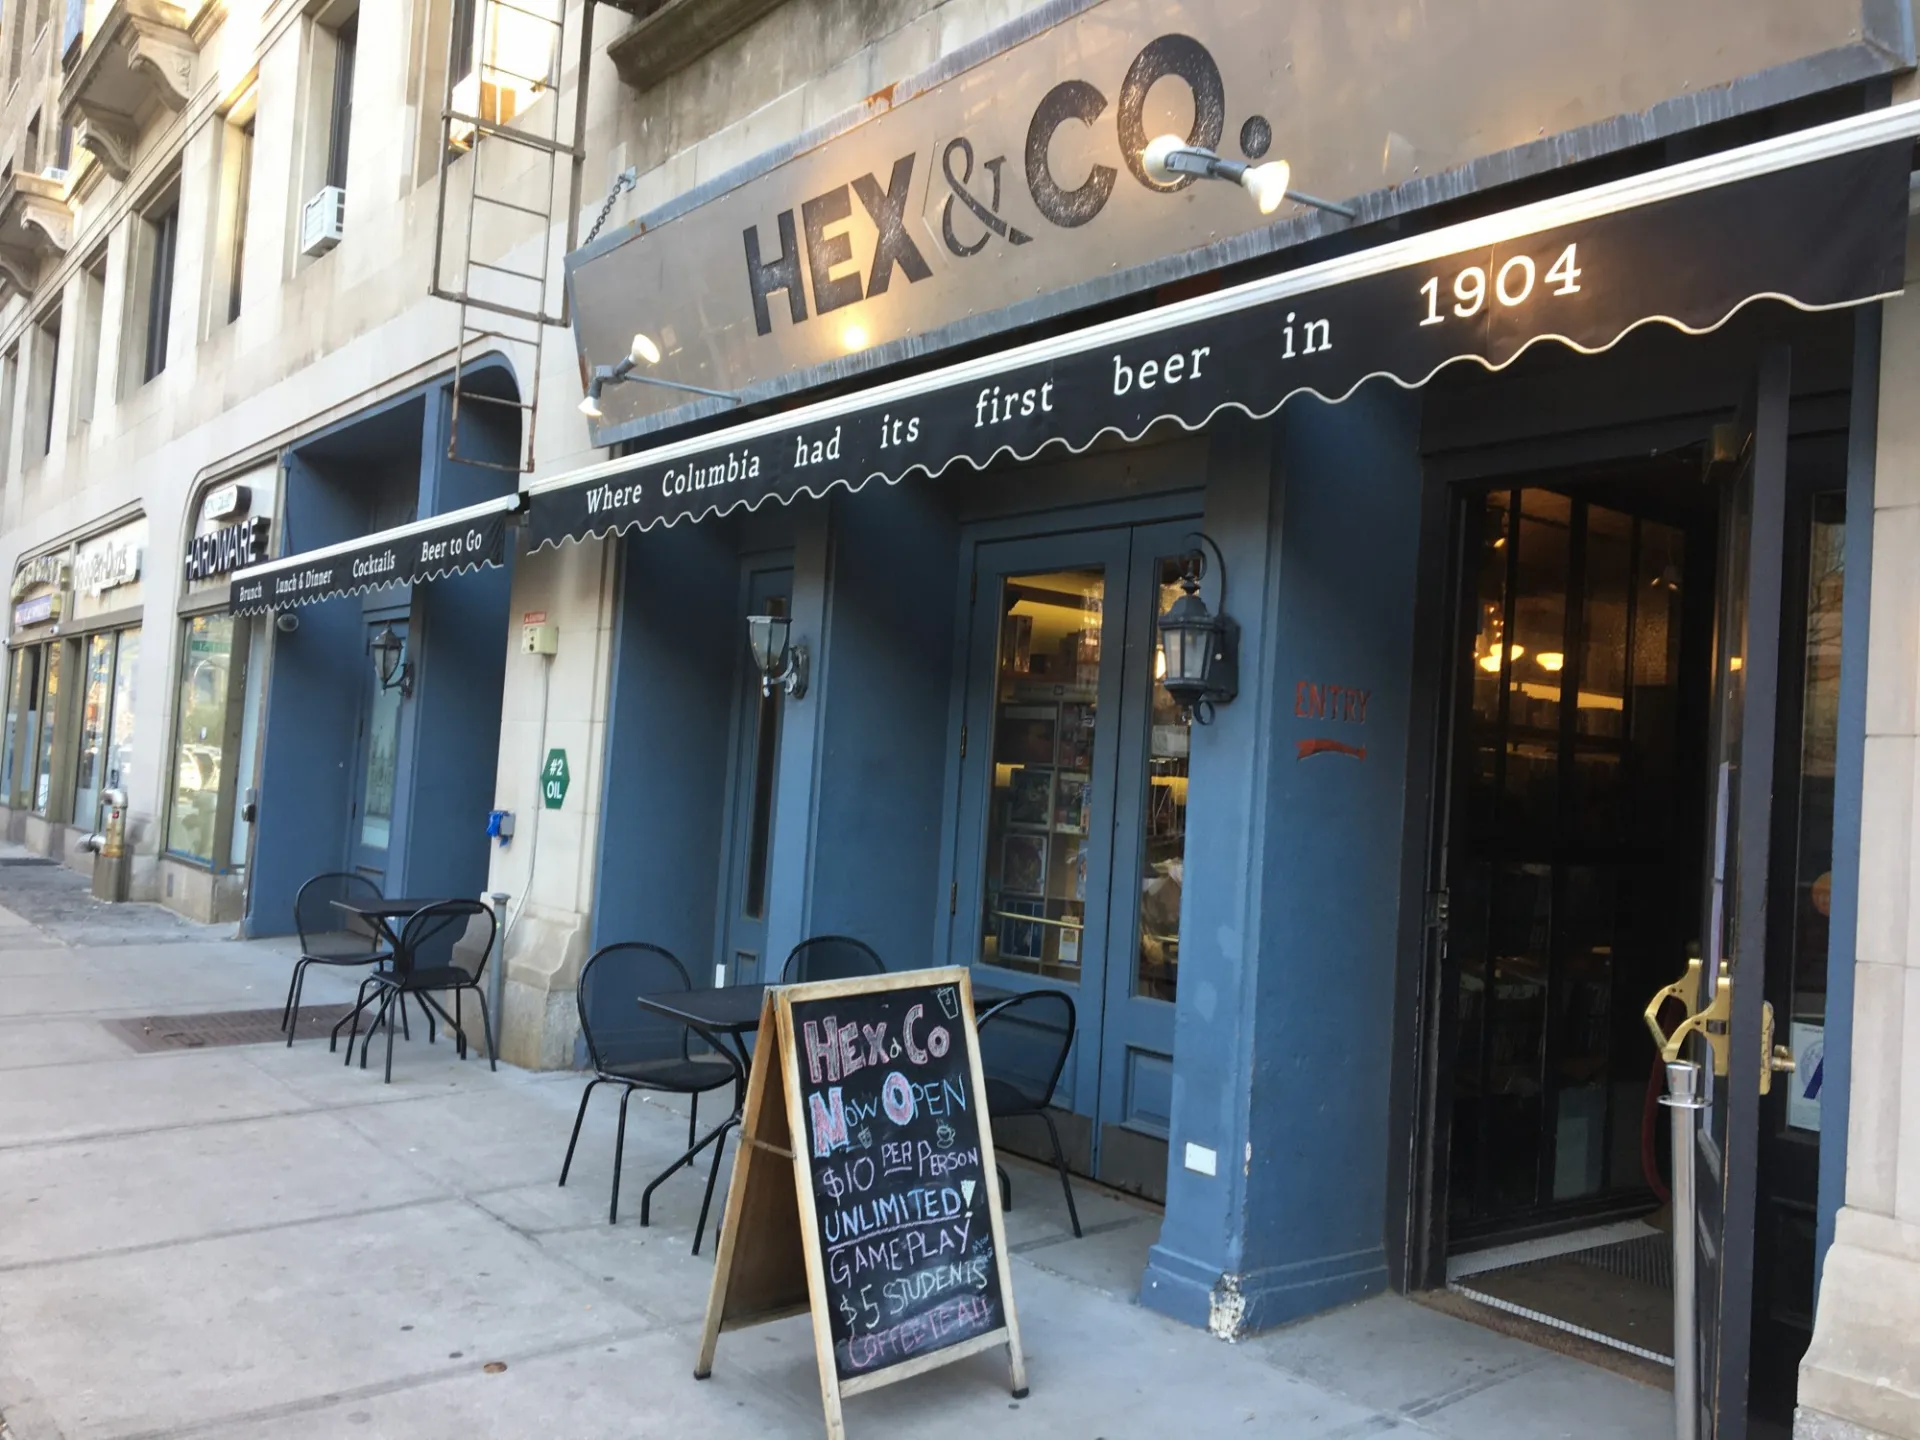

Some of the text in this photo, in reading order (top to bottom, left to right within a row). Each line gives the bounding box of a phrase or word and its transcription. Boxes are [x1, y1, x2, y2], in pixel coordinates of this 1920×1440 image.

[586, 243, 1583, 514] Where Columbia had its first beer in 1904
[185, 516, 259, 581] HARDWARE
[239, 581, 262, 602] Brunch
[276, 573, 297, 594] Lunch
[305, 568, 334, 589] Dinner
[352, 549, 396, 579] Cocktails
[421, 539, 446, 562] Beer
[450, 538, 462, 556] to
[466, 529, 482, 551] Go
[1294, 681, 1371, 724] ENTRY
[546, 781, 563, 799] OIL
[549, 759, 563, 776] #2
[882, 1071, 967, 1125] OPEN
[822, 1140, 979, 1207] $10 PER PERSON
[883, 1261, 988, 1315] STUDENTS
